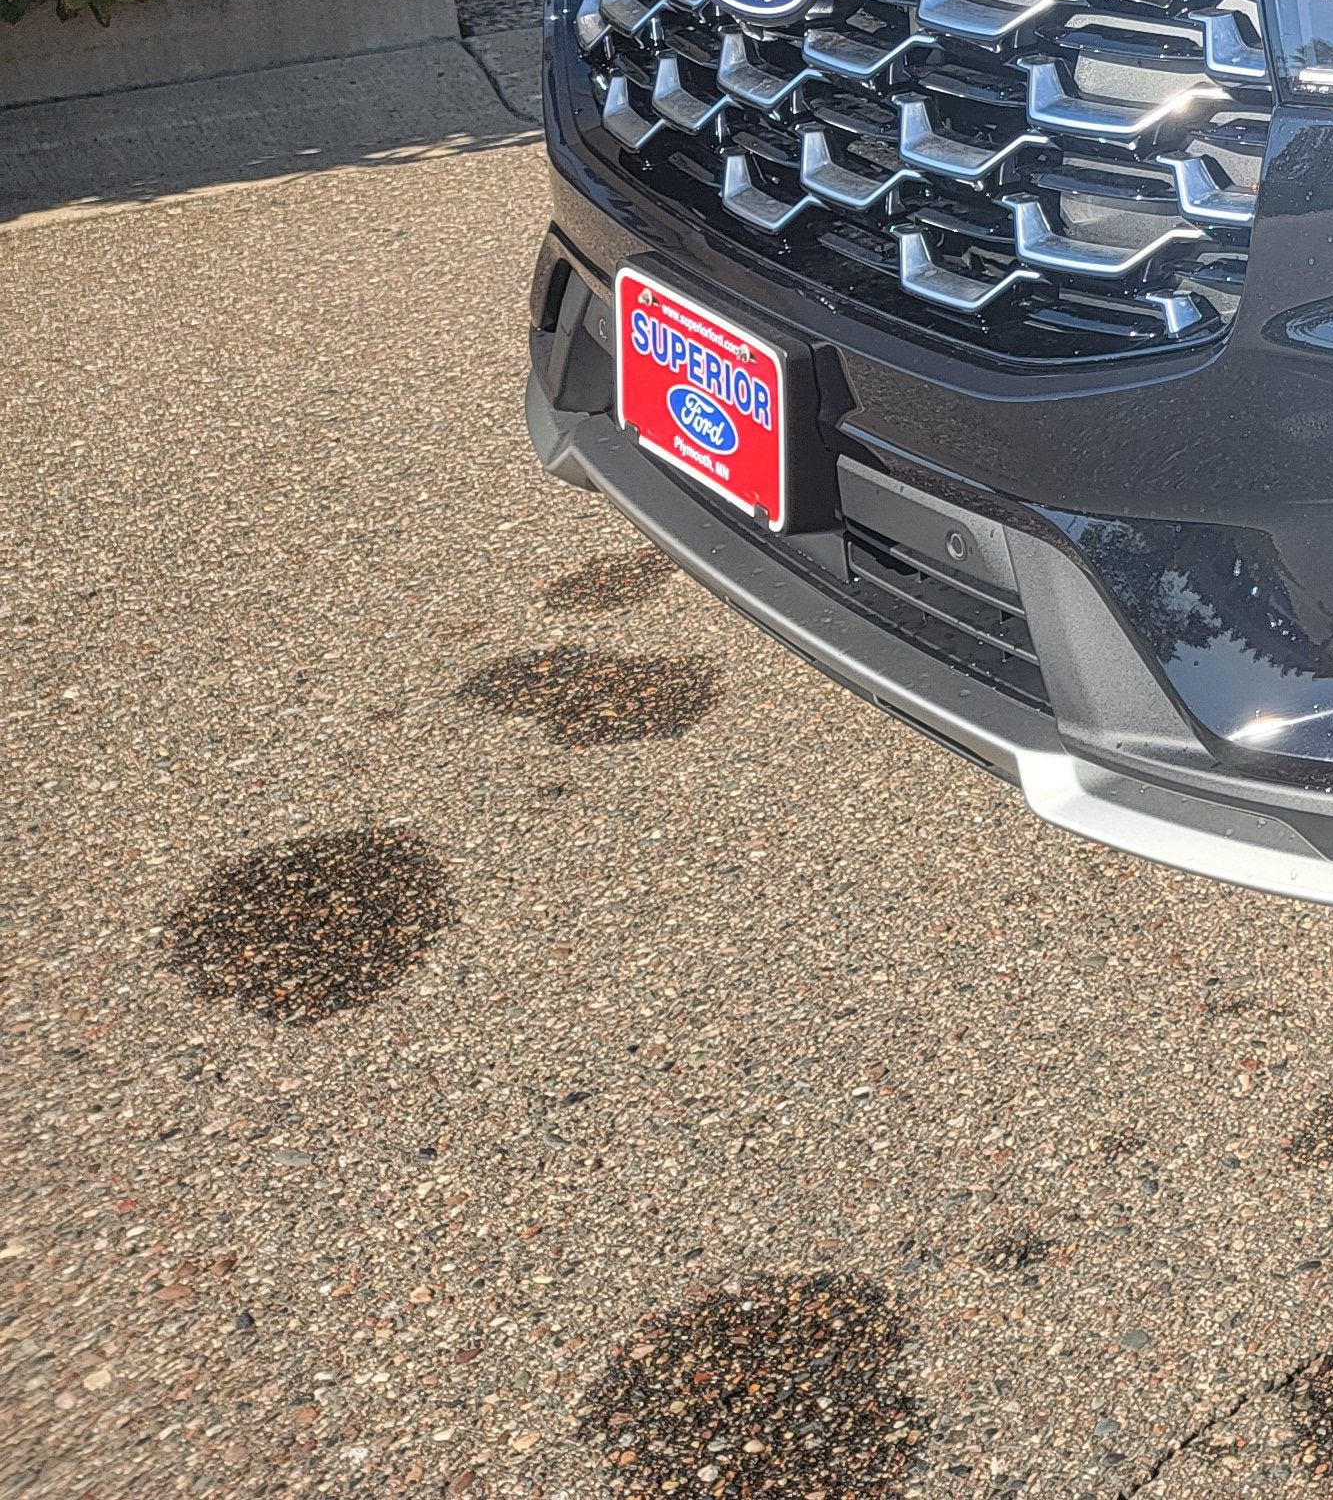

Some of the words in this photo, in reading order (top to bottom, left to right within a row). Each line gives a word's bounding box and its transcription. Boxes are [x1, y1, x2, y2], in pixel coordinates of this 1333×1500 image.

[632, 309, 772, 431] SUPERIOR
[681, 393, 724, 446] Ford
[673, 435, 714, 473] Plymouth,
[714, 461, 730, 481] MN
